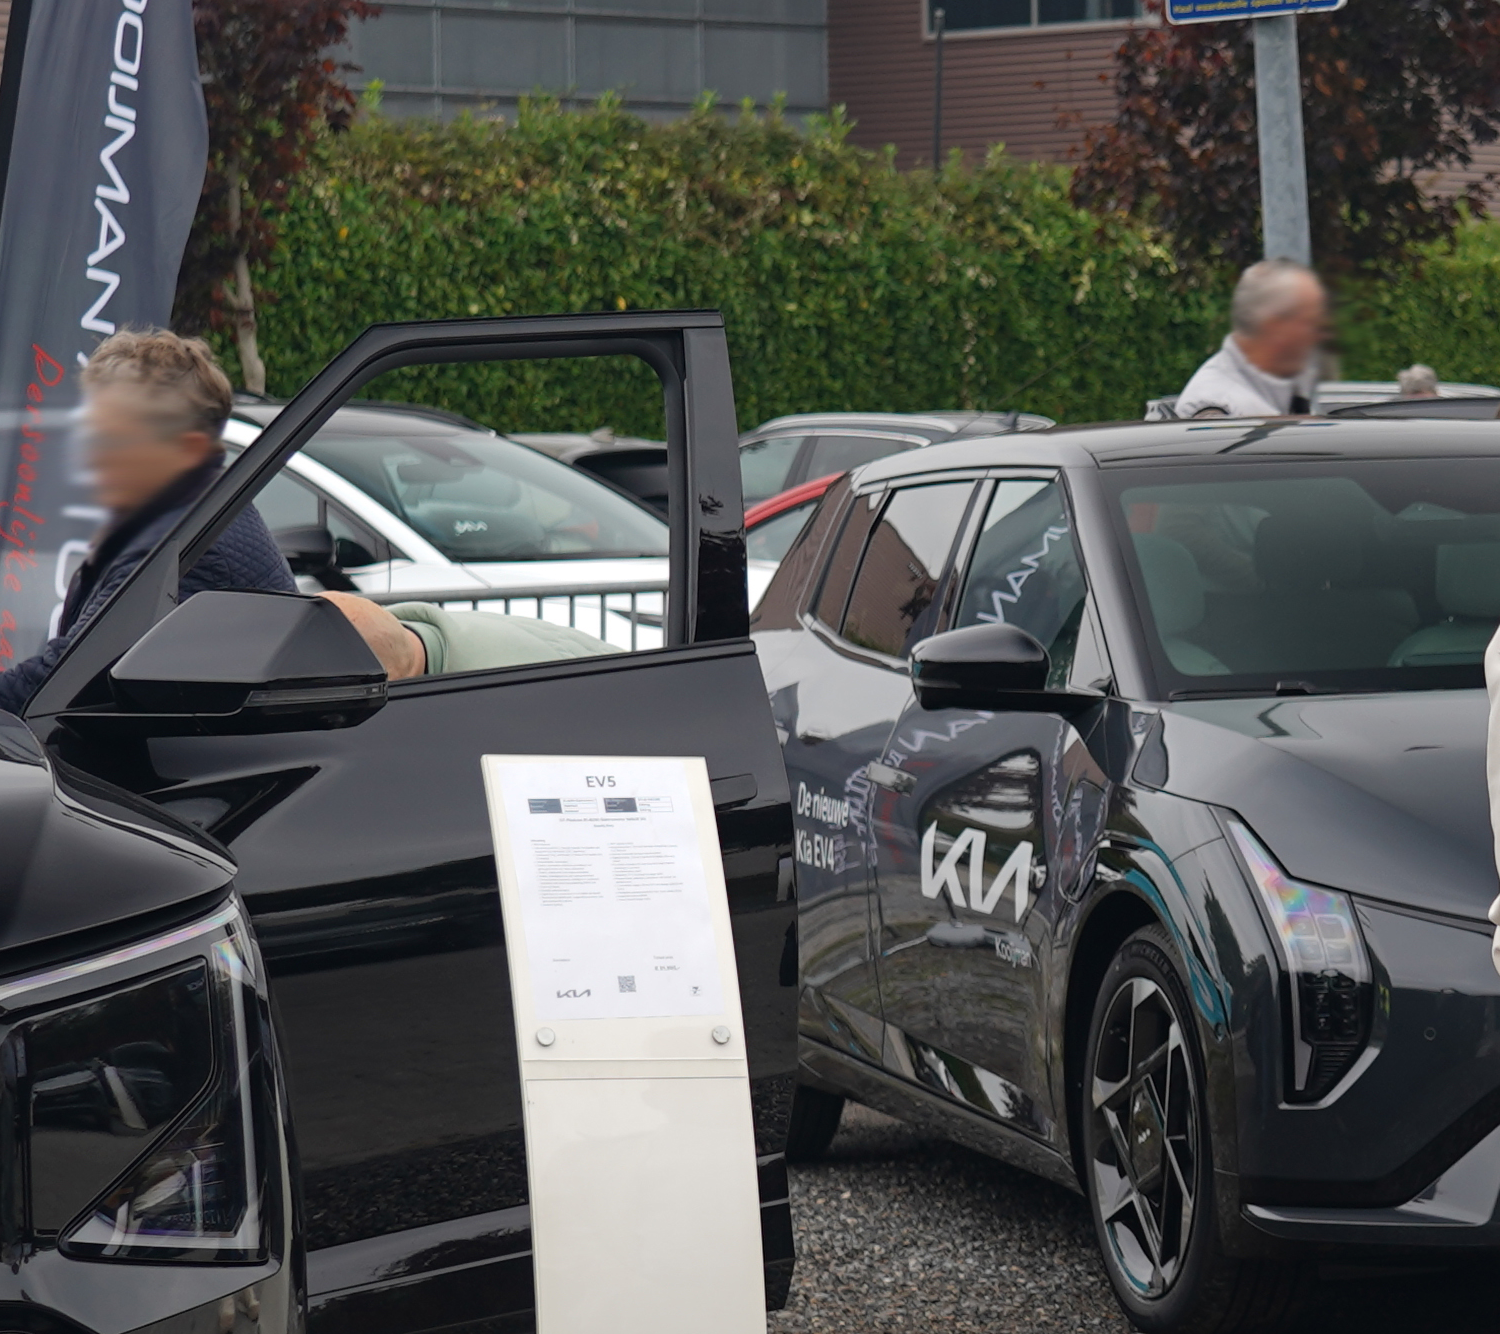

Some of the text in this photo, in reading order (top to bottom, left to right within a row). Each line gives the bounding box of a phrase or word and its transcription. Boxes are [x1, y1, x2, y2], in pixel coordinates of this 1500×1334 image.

[585, 775, 617, 788] EV5
[796, 781, 850, 828] De nieuwe
[795, 828, 835, 871] Kia EV4
[920, 820, 1034, 923] KIA
